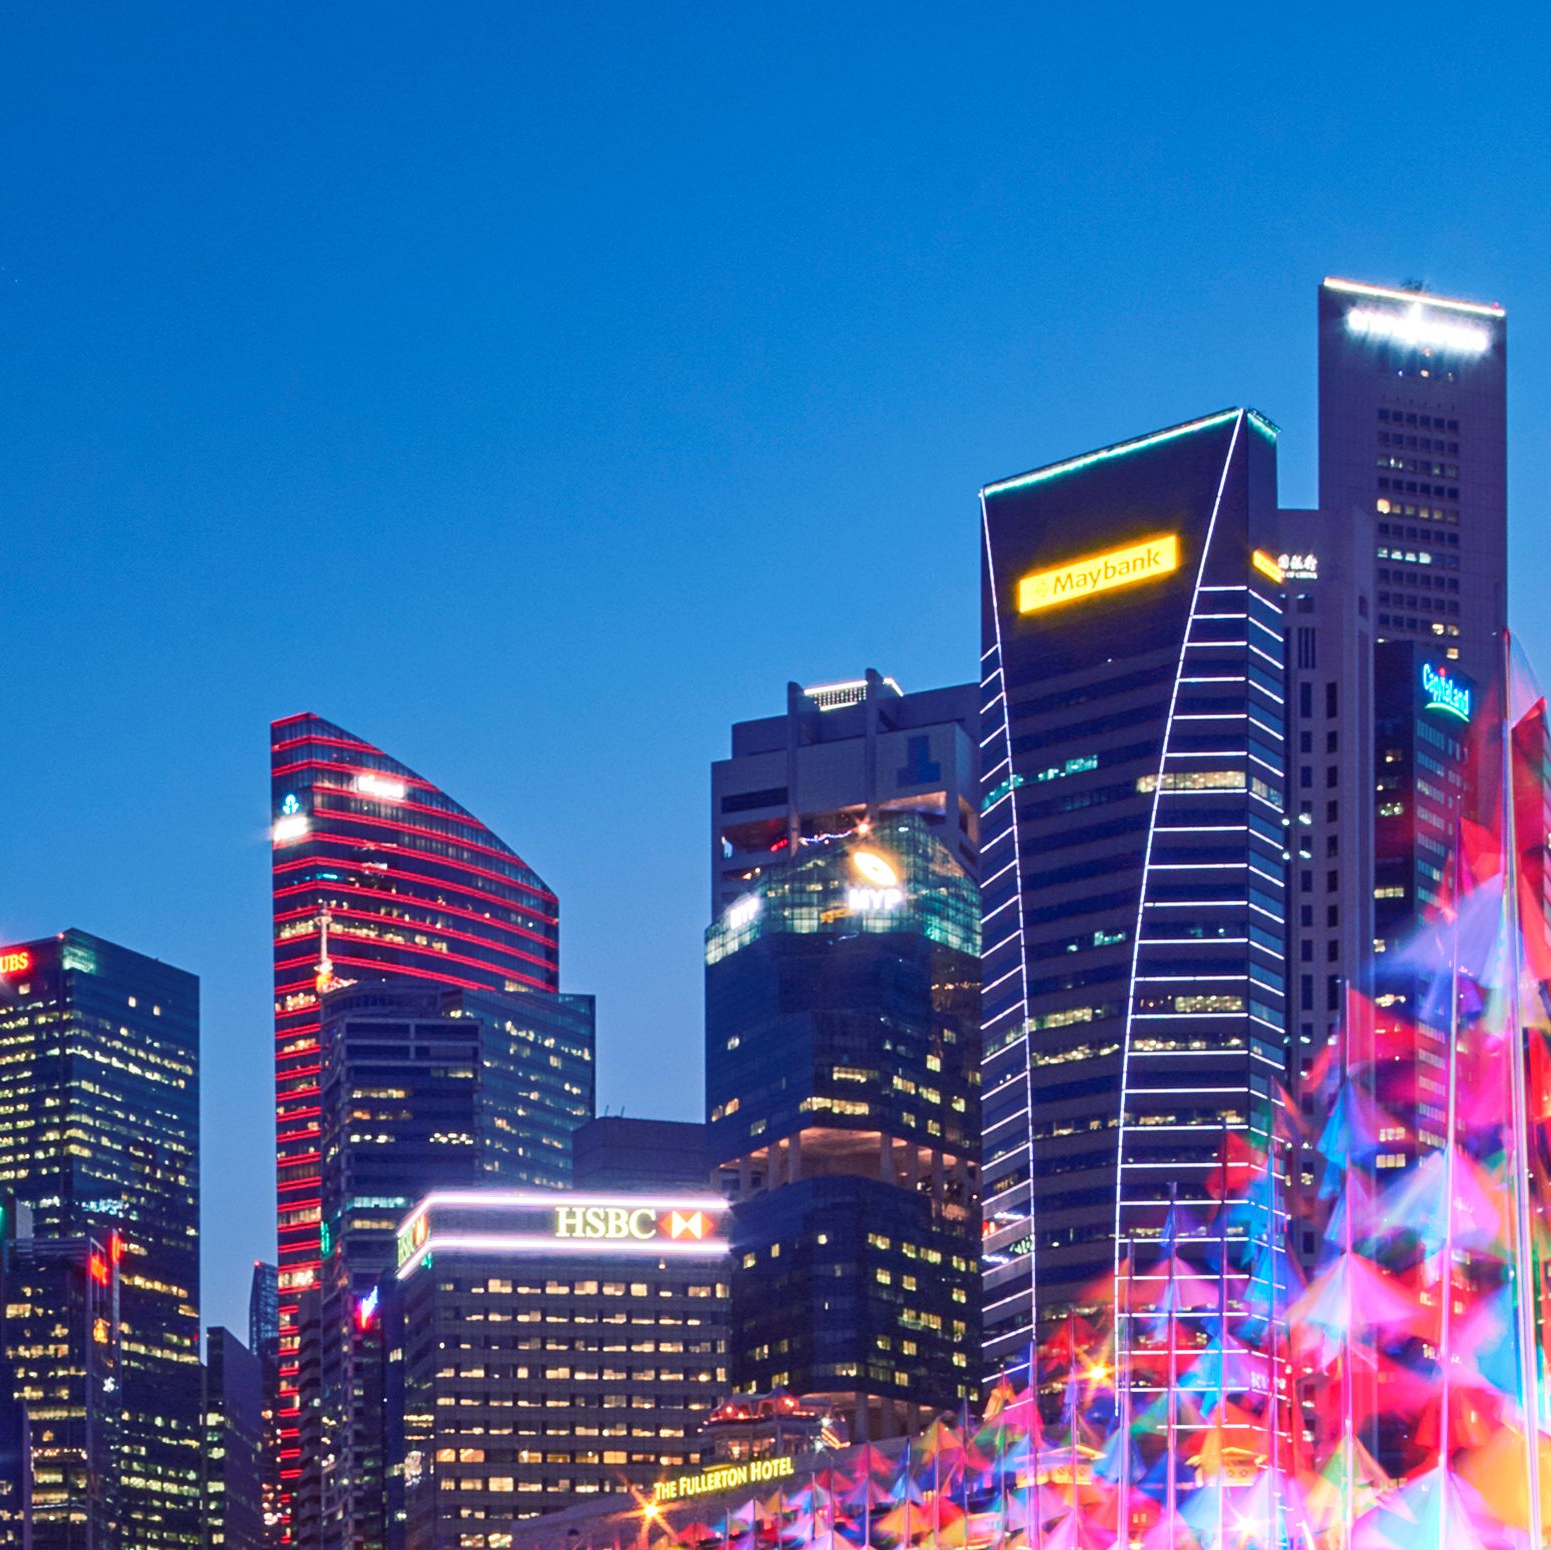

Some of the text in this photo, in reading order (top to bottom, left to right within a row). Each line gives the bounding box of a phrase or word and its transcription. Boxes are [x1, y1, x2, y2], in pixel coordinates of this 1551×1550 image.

[1052, 547, 1161, 595] Maybank
[555, 1207, 656, 1239] HSBC
[654, 1456, 794, 1500] THE FULLERTON HOTEL
